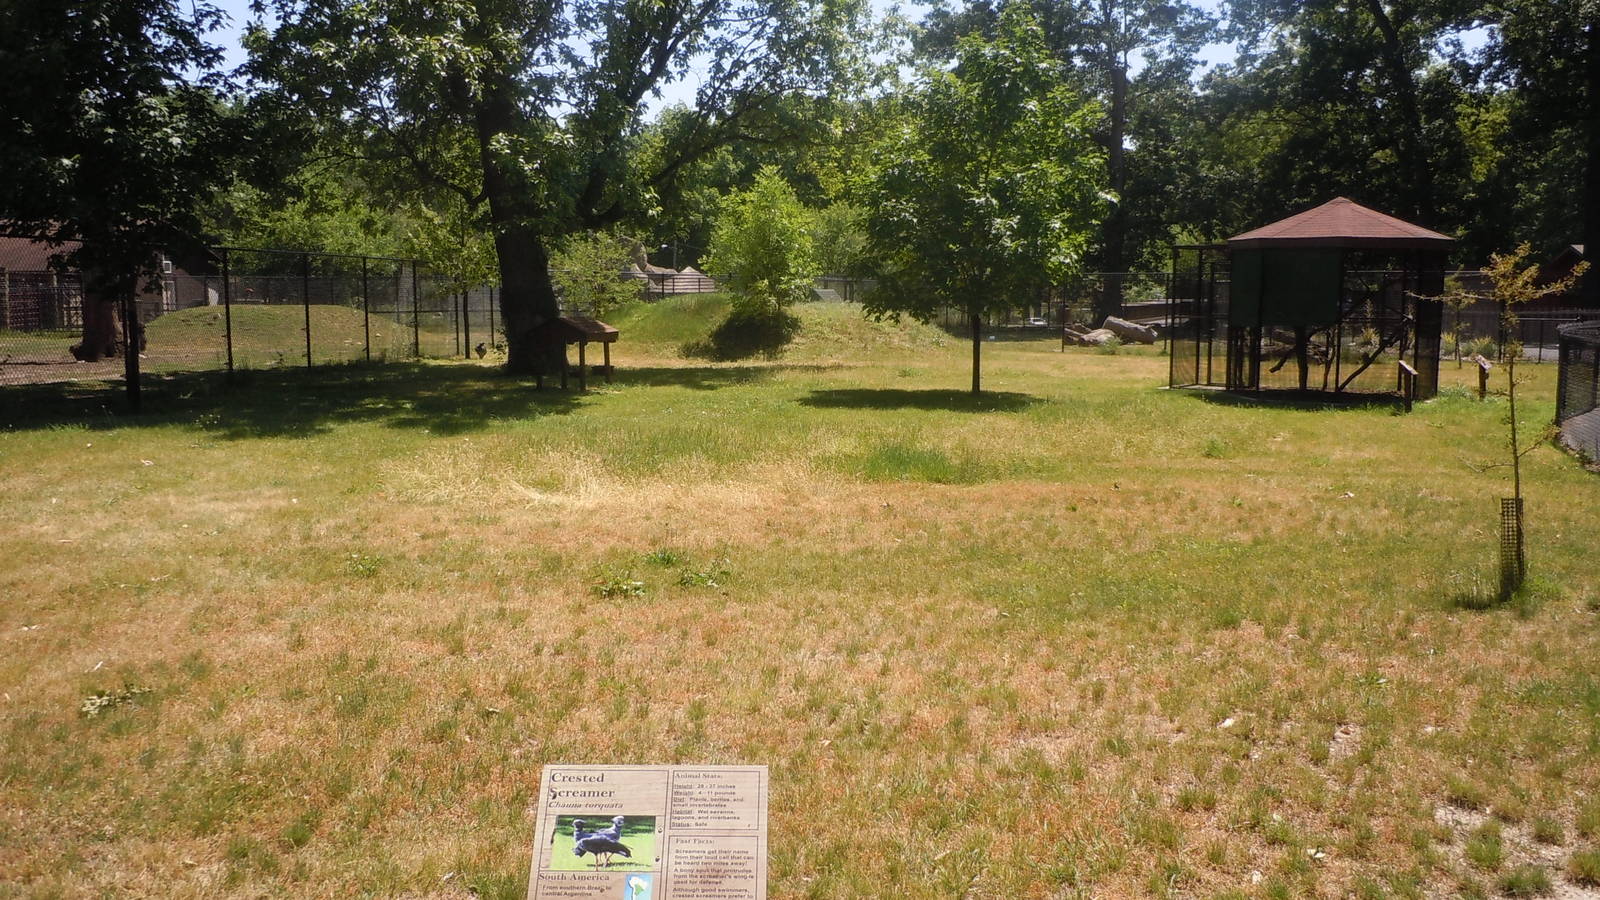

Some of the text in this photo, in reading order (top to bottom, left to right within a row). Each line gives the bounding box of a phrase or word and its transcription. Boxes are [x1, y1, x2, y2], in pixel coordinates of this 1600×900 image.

[551, 772, 604, 783] Crested
[549, 787, 615, 798] Screamer
[539, 873, 609, 881] South America
